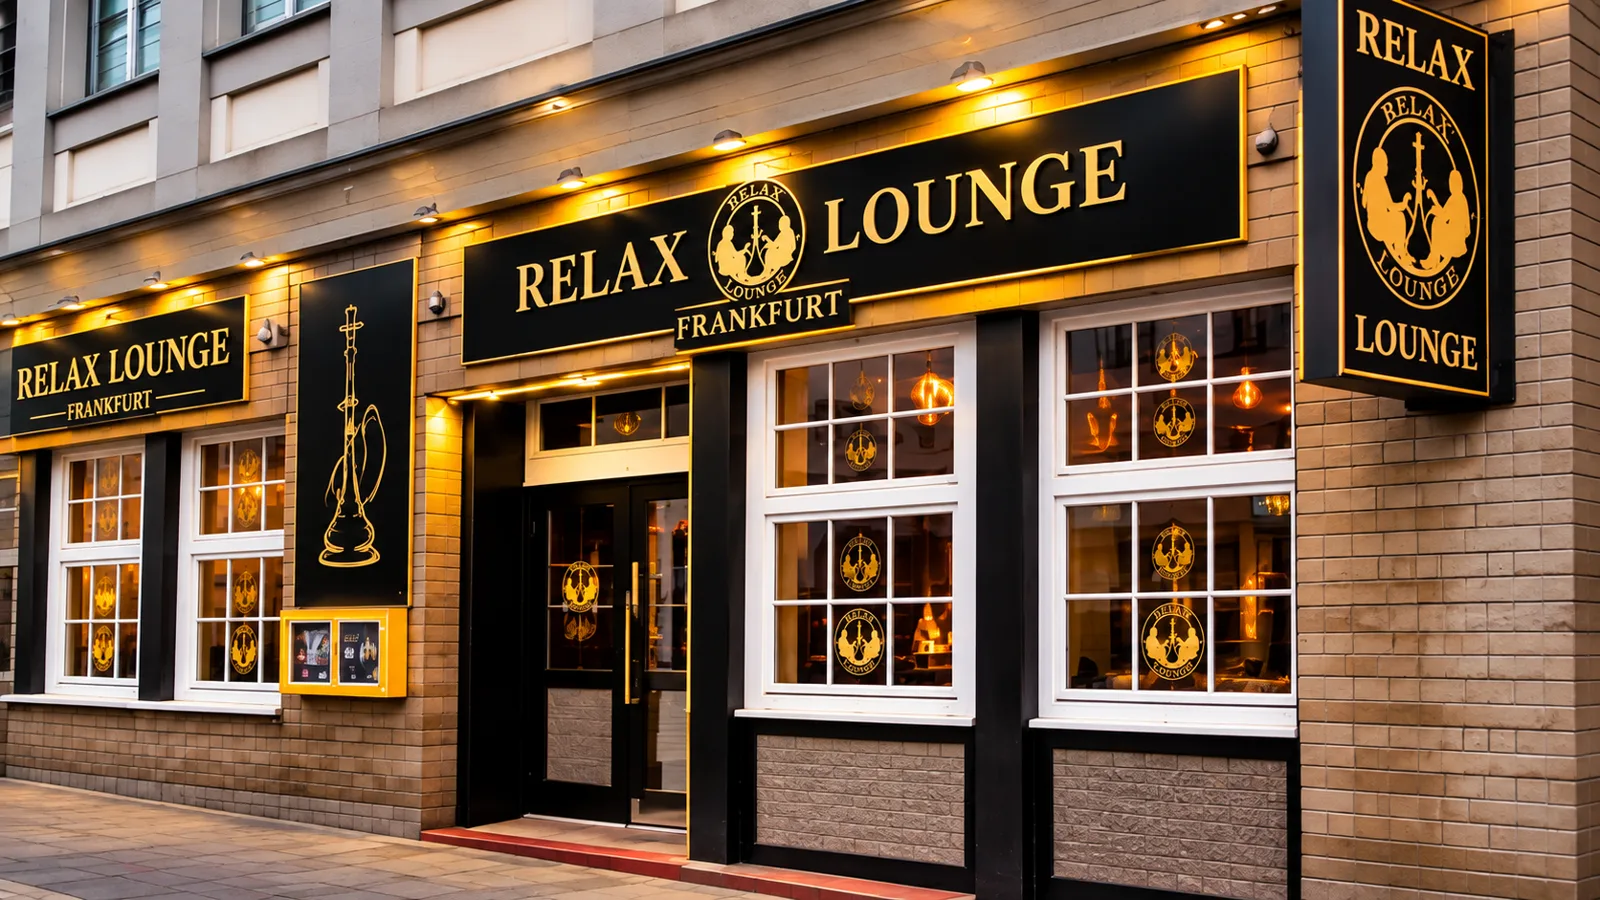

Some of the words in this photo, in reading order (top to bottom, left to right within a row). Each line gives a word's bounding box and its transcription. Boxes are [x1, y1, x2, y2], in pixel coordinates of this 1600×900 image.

[1357, 10, 1475, 91] RELAX
[728, 184, 785, 210] RELAX
[516, 231, 687, 312] RELAX
[824, 140, 1126, 253] LOUNGE
[724, 269, 787, 300] LOUNGE
[1377, 250, 1459, 300] LOUNGE
[677, 290, 842, 340] FRANKFURT
[18, 353, 100, 400] RELAX
[108, 328, 230, 383] LOUNGE
[1355, 315, 1478, 370] LOUNGE
[67, 389, 153, 421] FRANKFURT
